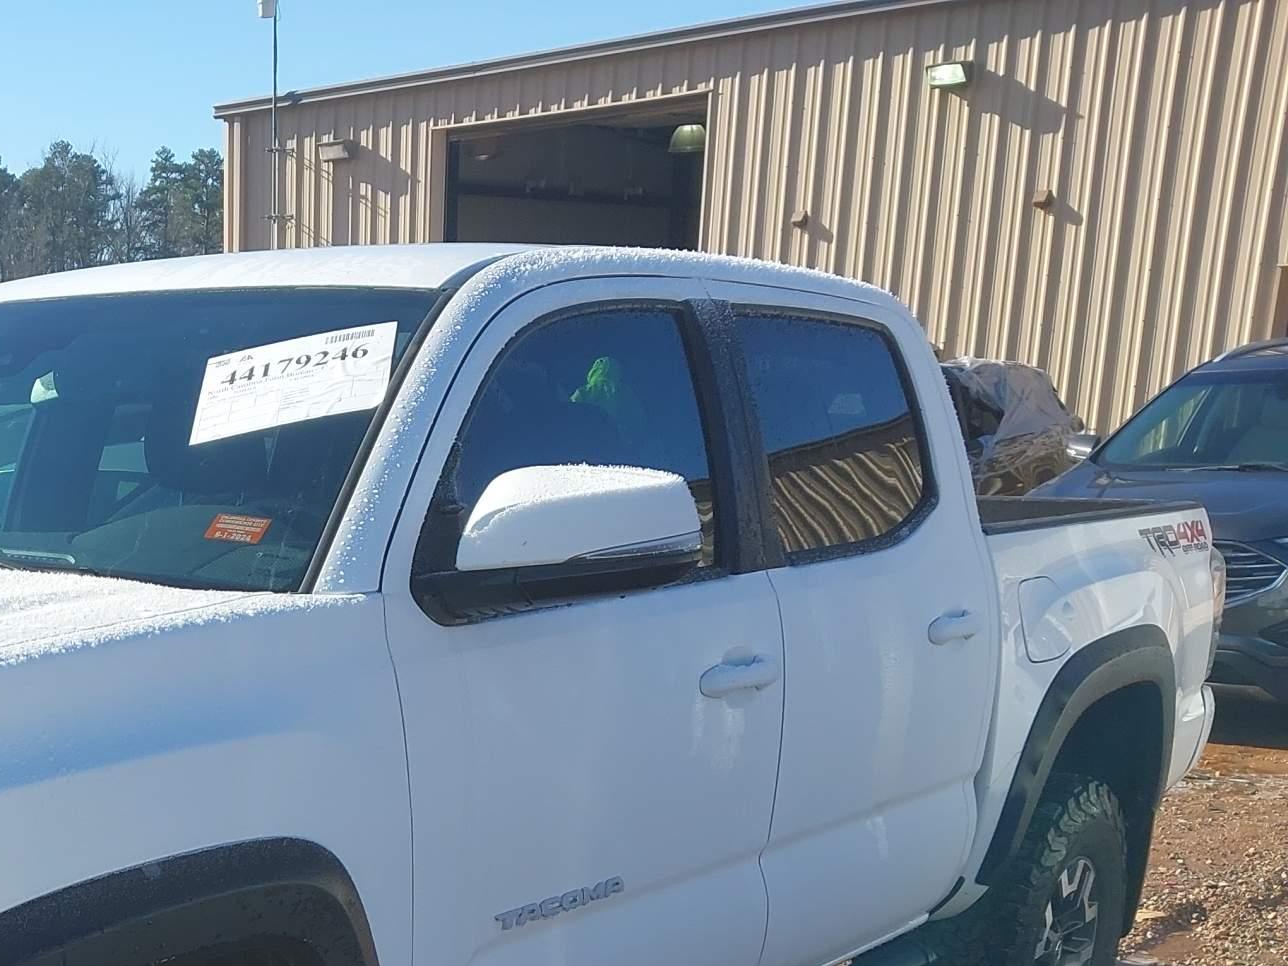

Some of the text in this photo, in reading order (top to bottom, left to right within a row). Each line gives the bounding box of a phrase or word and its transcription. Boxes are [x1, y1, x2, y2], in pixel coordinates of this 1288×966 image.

[220, 342, 370, 385] 44179246
[1138, 525, 1181, 558] TRD
[494, 876, 625, 930] TACOMA
